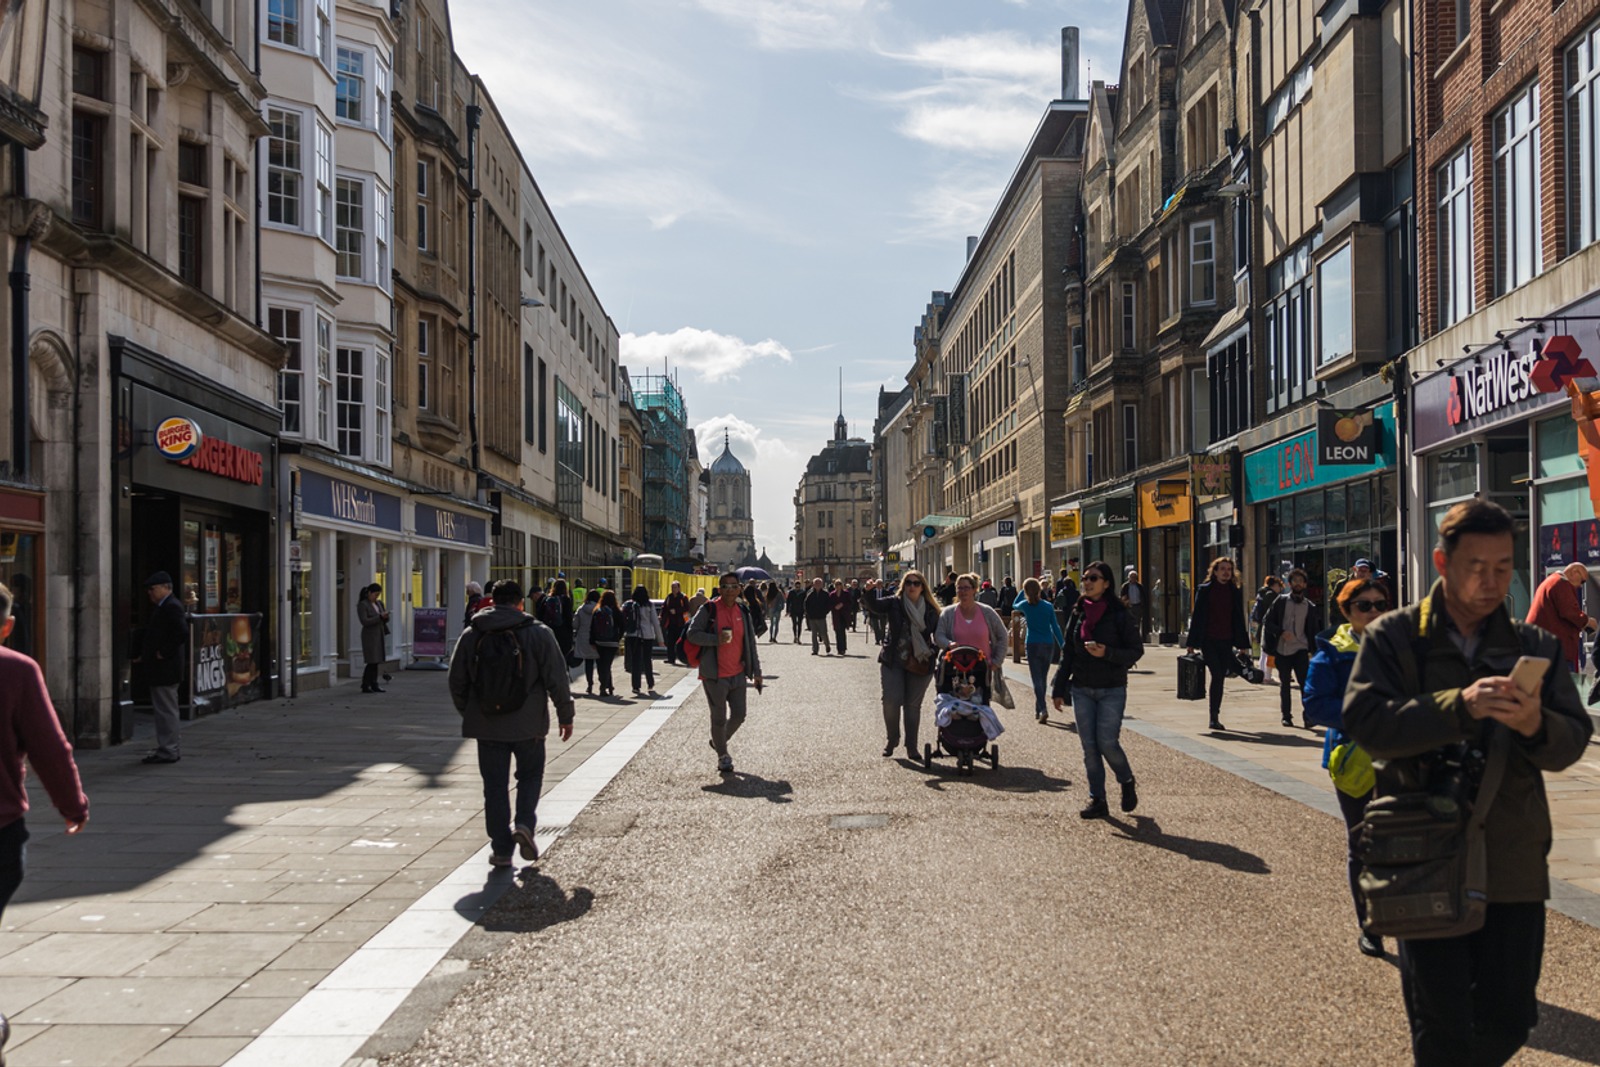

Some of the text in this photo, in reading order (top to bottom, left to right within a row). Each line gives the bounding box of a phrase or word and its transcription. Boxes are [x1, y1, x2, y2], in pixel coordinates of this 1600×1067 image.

[1465, 339, 1537, 420] NatWest
[158, 424, 191, 438] BURGER
[160, 431, 192, 448] KING
[1326, 446, 1368, 460] LEON
[181, 433, 263, 487] RGER KING
[1278, 436, 1314, 490] LEON
[331, 480, 376, 525] WHSmith
